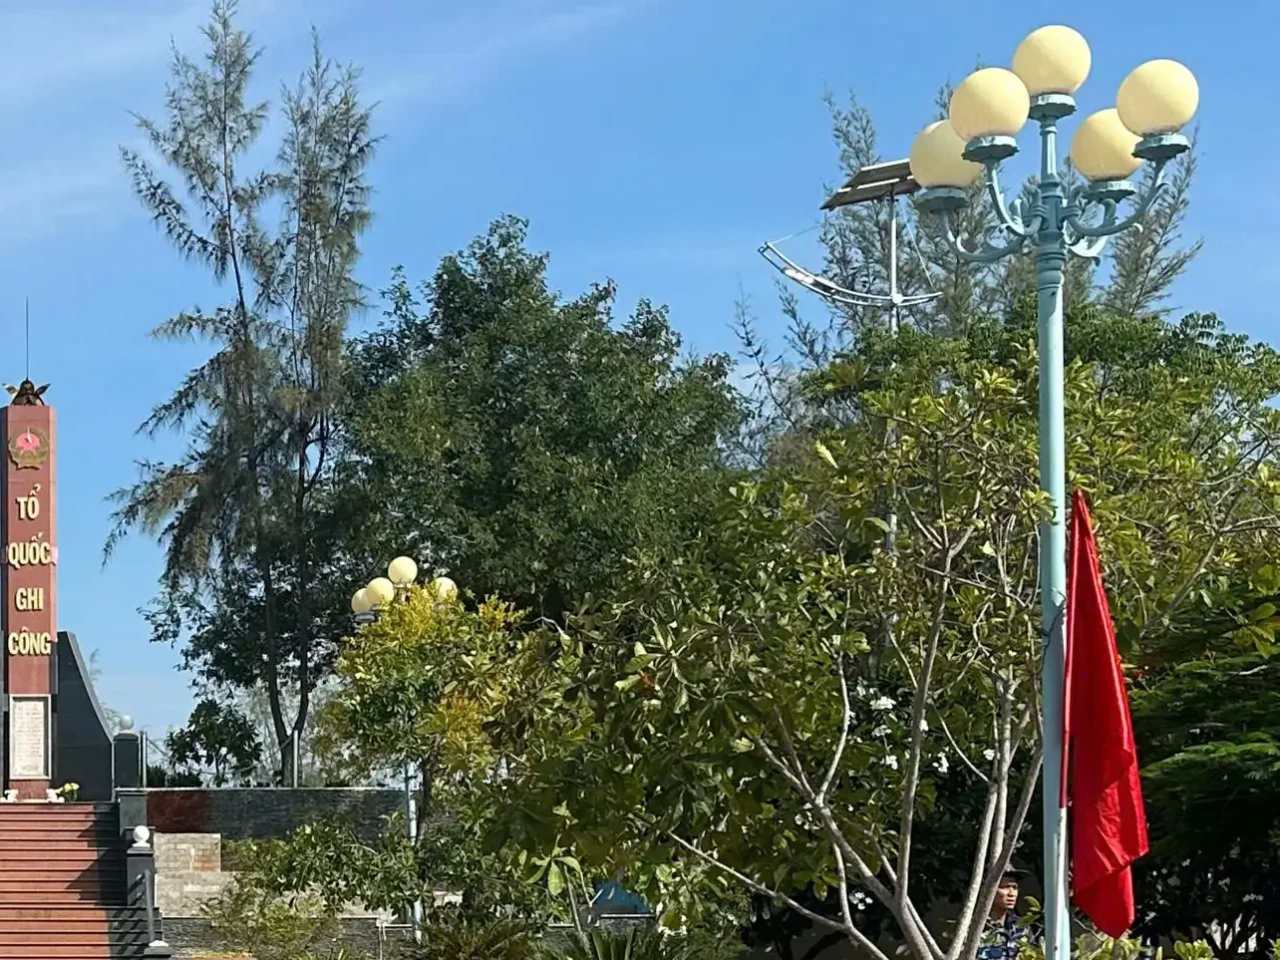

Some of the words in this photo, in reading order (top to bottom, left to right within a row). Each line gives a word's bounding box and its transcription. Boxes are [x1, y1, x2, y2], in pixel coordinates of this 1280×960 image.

[16, 483, 41, 519] TỔ
[8, 532, 51, 569] QUỐC
[15, 587, 44, 610] GHI
[8, 626, 52, 655] CÔNG
